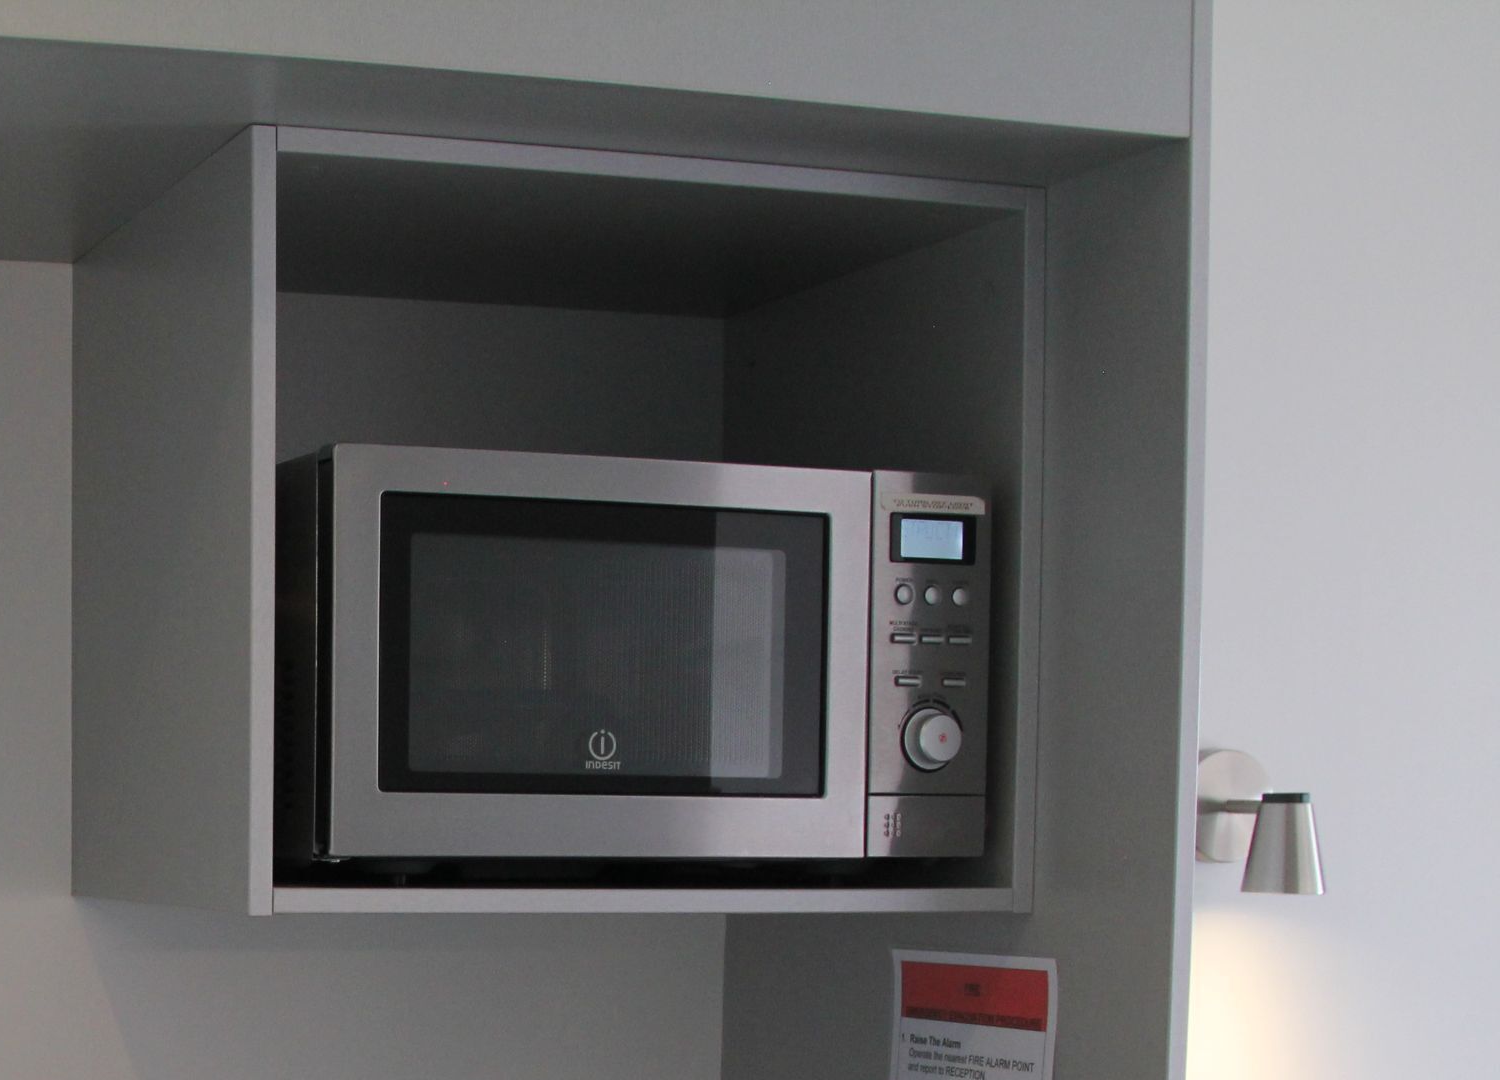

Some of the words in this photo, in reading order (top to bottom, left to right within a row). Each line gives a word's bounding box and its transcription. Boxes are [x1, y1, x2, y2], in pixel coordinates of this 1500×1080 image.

[910, 1034, 927, 1046] Raise
[929, 1036, 940, 1046] The
[942, 1038, 961, 1049] Alarm
[908, 1047, 932, 1061] Operate
[934, 1051, 943, 1061] the
[945, 1053, 967, 1064] nearest
[969, 1055, 984, 1067] FIRE
[985, 1057, 1010, 1070] ALARM
[1011, 1060, 1035, 1072] POINT
[908, 1062, 918, 1071] and
[920, 1065, 937, 1075] report
[938, 1066, 944, 1075] to
[945, 1066, 985, 1080] RECEPTION
